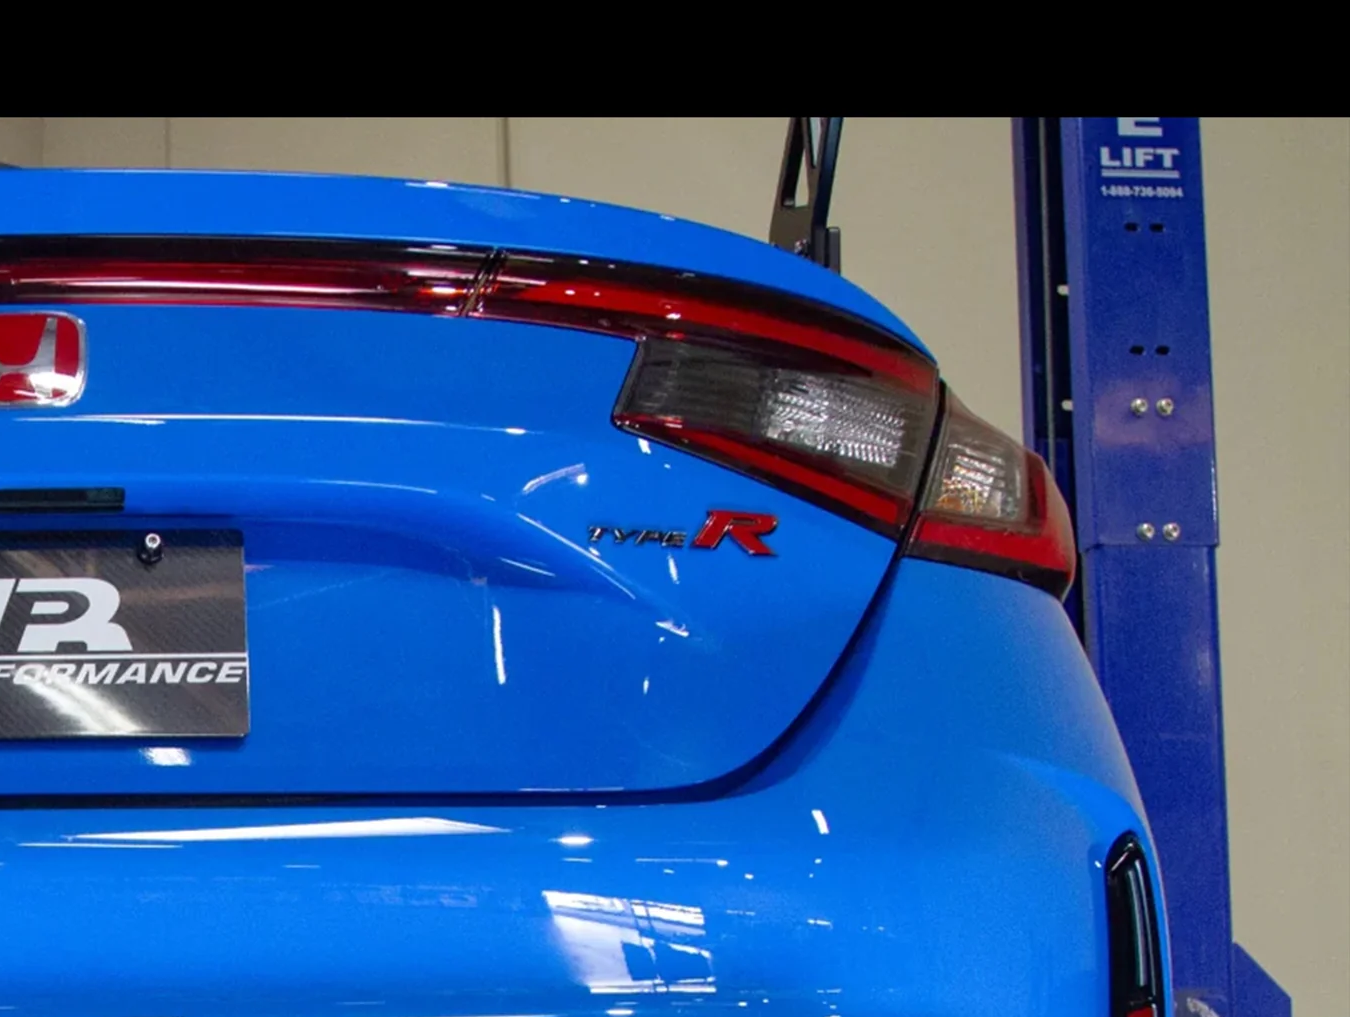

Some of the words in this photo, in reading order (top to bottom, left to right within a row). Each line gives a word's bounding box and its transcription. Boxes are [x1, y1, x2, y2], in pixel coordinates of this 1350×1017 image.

[1100, 146, 1180, 168] LIFT
[588, 525, 687, 547] TYPE
[691, 509, 779, 557] R
